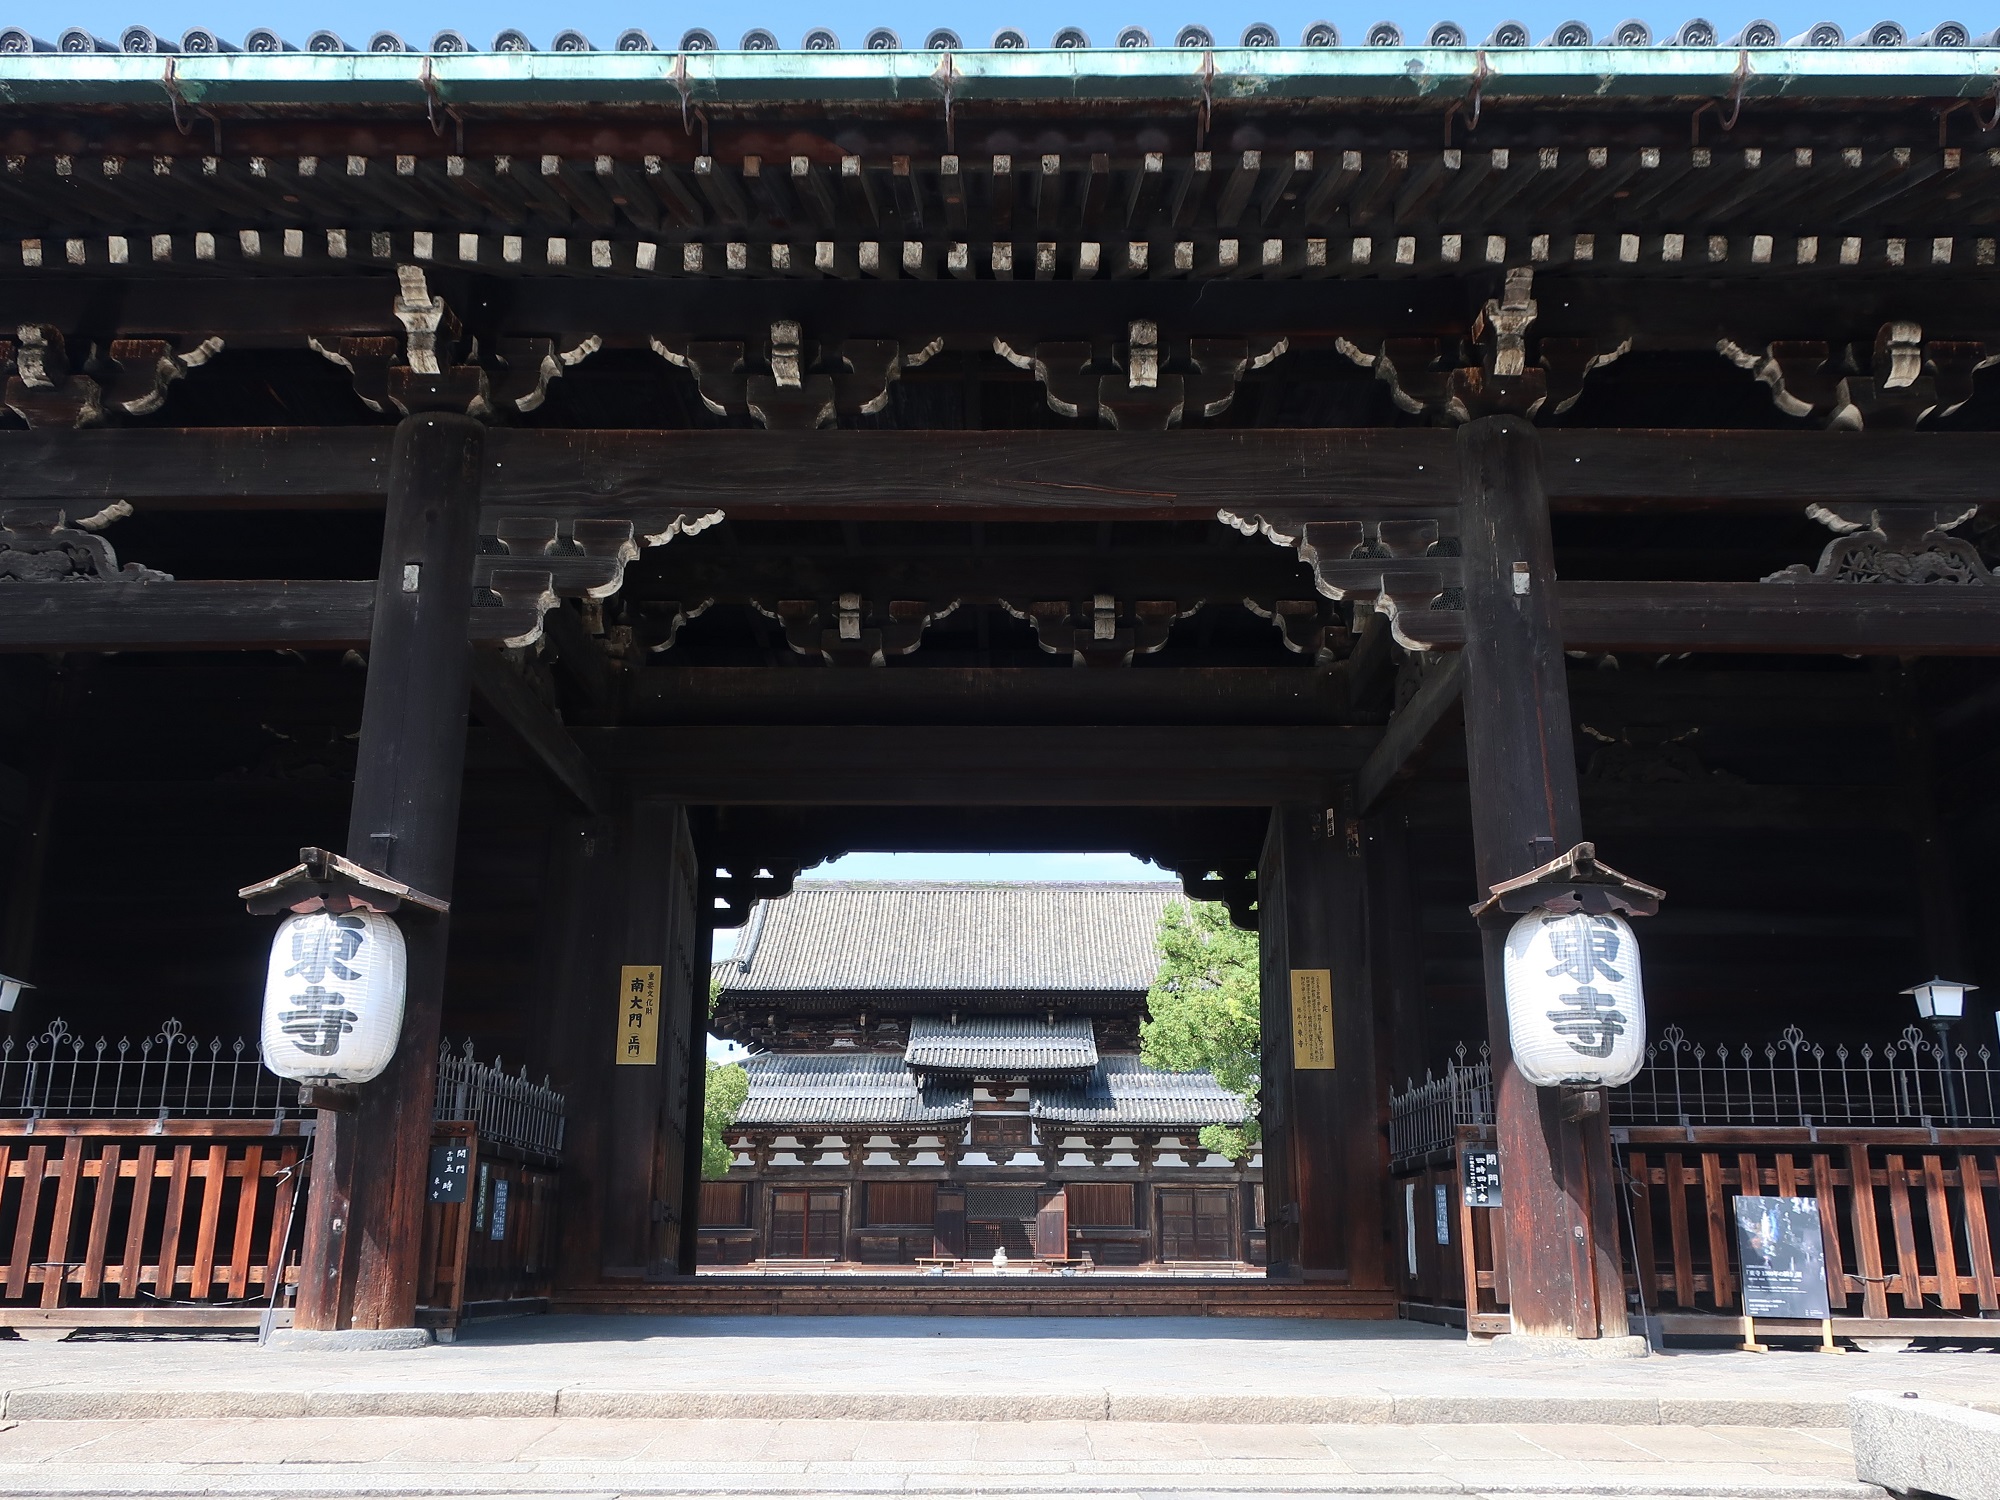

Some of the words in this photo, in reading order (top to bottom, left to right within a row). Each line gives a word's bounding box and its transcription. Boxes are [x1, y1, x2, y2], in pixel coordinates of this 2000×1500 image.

[278, 912, 365, 1056] 東寺
[645, 971, 655, 1016] 重要文化財
[1543, 914, 1627, 1058] 東寺
[455, 1149, 467, 1174] 開門
[1486, 1153, 1499, 1186] 閉門
[432, 1176, 440, 1199] 東寺
